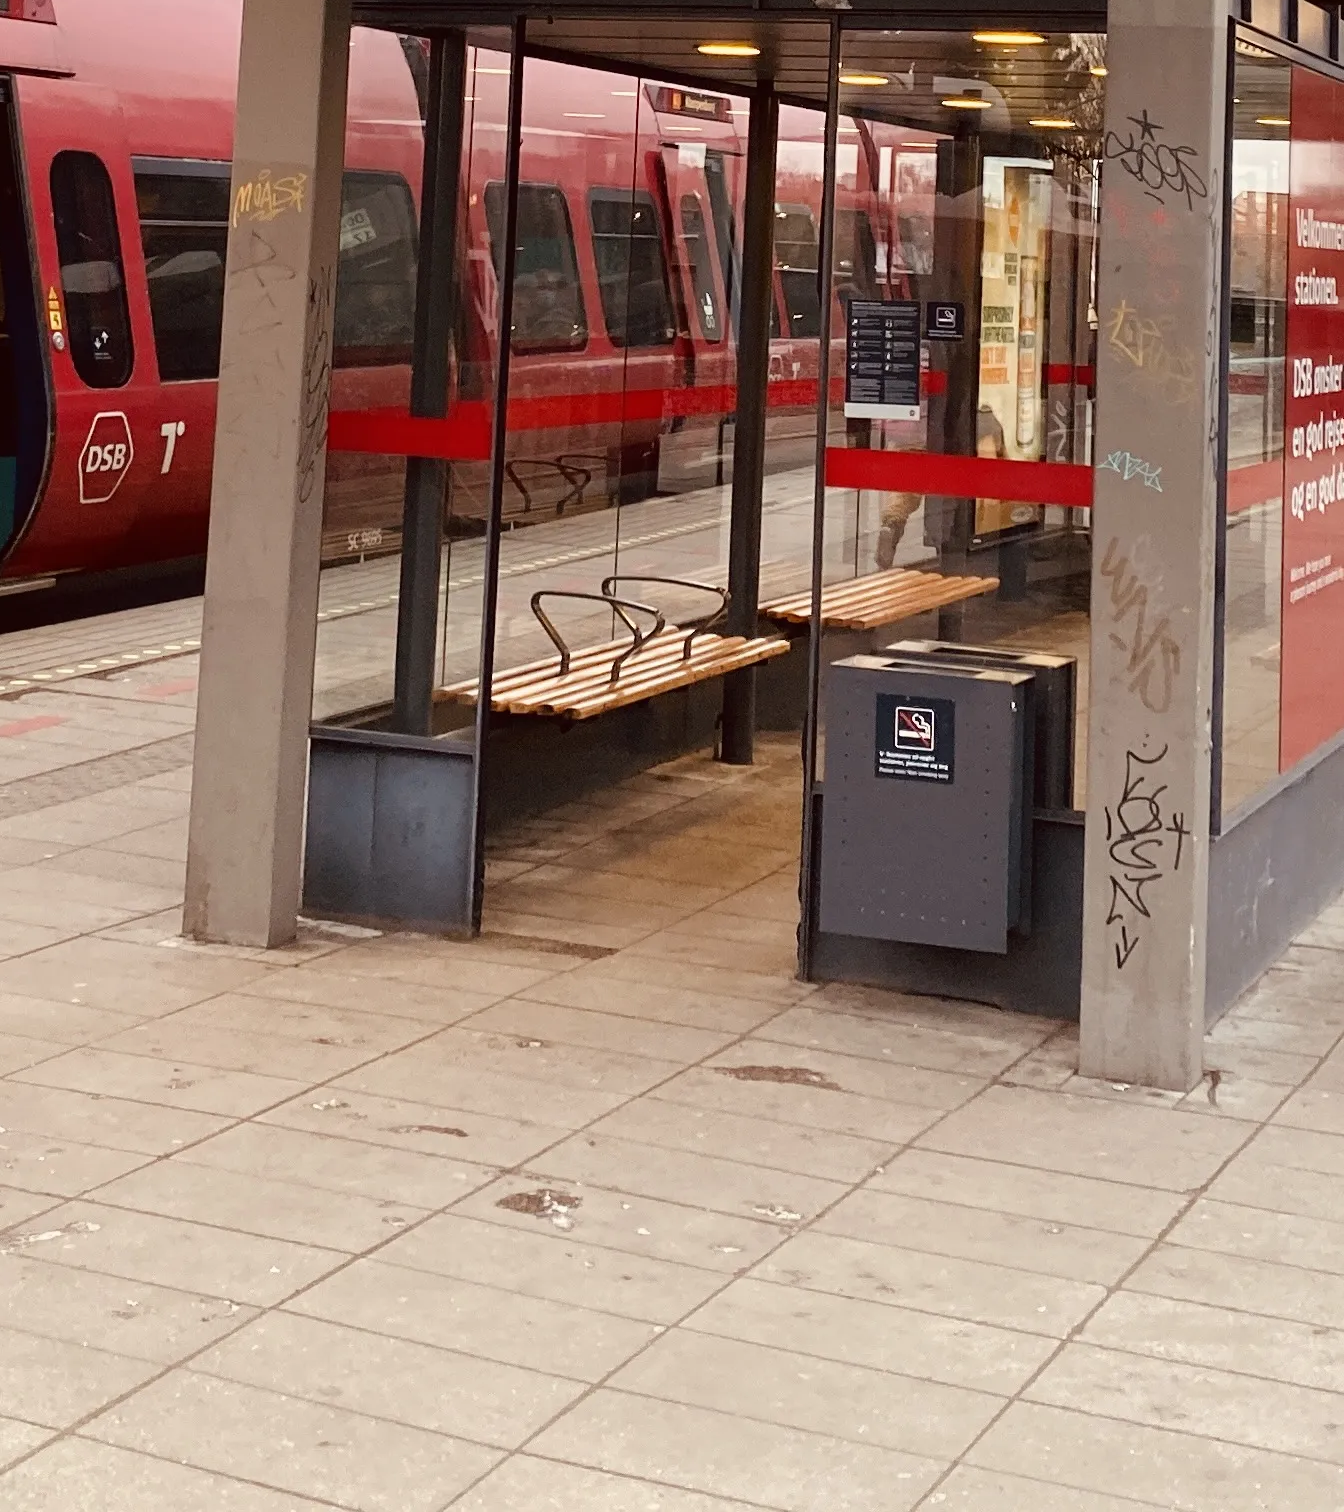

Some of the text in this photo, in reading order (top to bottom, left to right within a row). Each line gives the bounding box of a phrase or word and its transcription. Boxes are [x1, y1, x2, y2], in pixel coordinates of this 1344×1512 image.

[1295, 267, 1339, 306] stationen.
[1293, 357, 1313, 398] DSB
[1292, 426, 1305, 458] en
[1306, 411, 1324, 461] god
[85, 443, 127, 474] DSB
[1291, 483, 1304, 522] og
[1305, 479, 1317, 512] en
[1318, 464, 1336, 515] god
